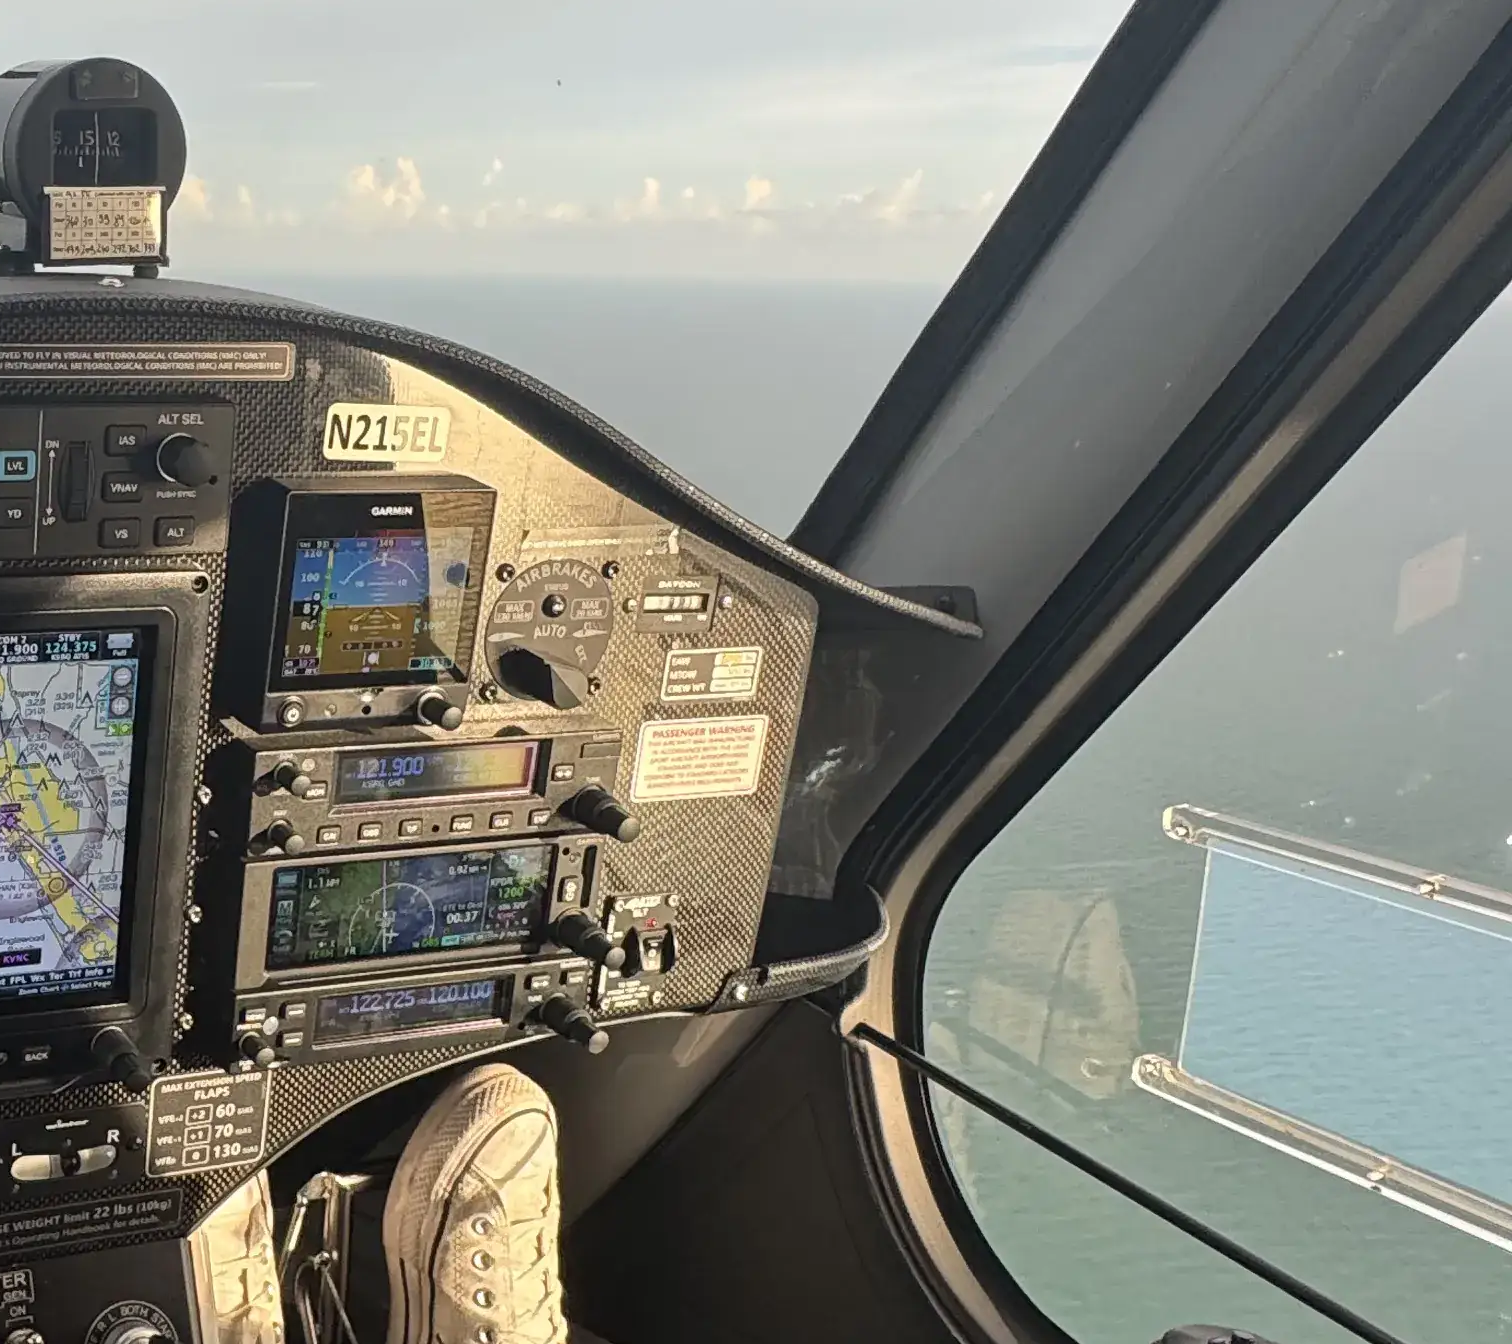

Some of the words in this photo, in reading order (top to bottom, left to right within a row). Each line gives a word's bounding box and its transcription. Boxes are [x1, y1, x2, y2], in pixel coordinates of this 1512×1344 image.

[79, 130, 95, 145] 15
[107, 131, 120, 147] 12
[23, 352, 34, 360] TO
[36, 352, 50, 360] FLY
[168, 351, 218, 360] CONDITIONS
[4, 362, 68, 370] INSTRUMENTAL
[145, 362, 195, 370] CONDITIONS
[158, 413, 179, 425] ALT
[181, 413, 204, 425] SEL
[327, 413, 442, 453] N215EL
[45, 440, 59, 449] DN
[118, 436, 136, 446] IAS
[7, 460, 25, 471] LVL
[110, 484, 138, 493] VNAV
[156, 490, 175, 499] PUSH
[177, 490, 197, 499] SYNC
[7, 509, 22, 520] YD
[371, 506, 413, 517] GARMIN
[42, 516, 56, 526] UP
[114, 529, 129, 539] VS
[167, 527, 185, 537] ALT
[515, 562, 599, 593] AIRBRAKES
[59, 633, 82, 642] STBY
[533, 624, 567, 639] AUTO
[45, 640, 97, 654] 124.375
[652, 727, 706, 738] PASSENGER
[708, 725, 756, 735] WARNING
[356, 756, 426, 779] 121.900
[498, 886, 525, 899] 1200
[10, 974, 27, 985] FPL
[85, 966, 103, 977] Info
[350, 990, 416, 1015] 122.725
[429, 980, 494, 1004] 120.100
[25, 1052, 48, 1061] BACK
[161, 1082, 183, 1094] MAX
[184, 1075, 234, 1090] EXTENSION
[235, 1072, 262, 1084] SPEED
[194, 1087, 230, 1101] FLAPS
[191, 1109, 206, 1120] +2
[215, 1102, 236, 1118] 60
[106, 1129, 120, 1143] R
[190, 1130, 204, 1141] +1
[214, 1123, 234, 1138] 70
[11, 1142, 22, 1156] L
[212, 1142, 241, 1158] 130
[12, 1214, 62, 1233] WEIGHT
[63, 1210, 90, 1223] limit
[92, 1206, 110, 1220] 22
[113, 1202, 134, 1216] lbs
[136, 1199, 173, 1215] (10kg)
[11, 1229, 61, 1246] Operating
[62, 1221, 111, 1237] Handbook
[3, 1290, 28, 1302] GEN
[9, 1305, 27, 1317] ON
[120, 1305, 149, 1317] BOTH
[107, 1312, 117, 1323] L
